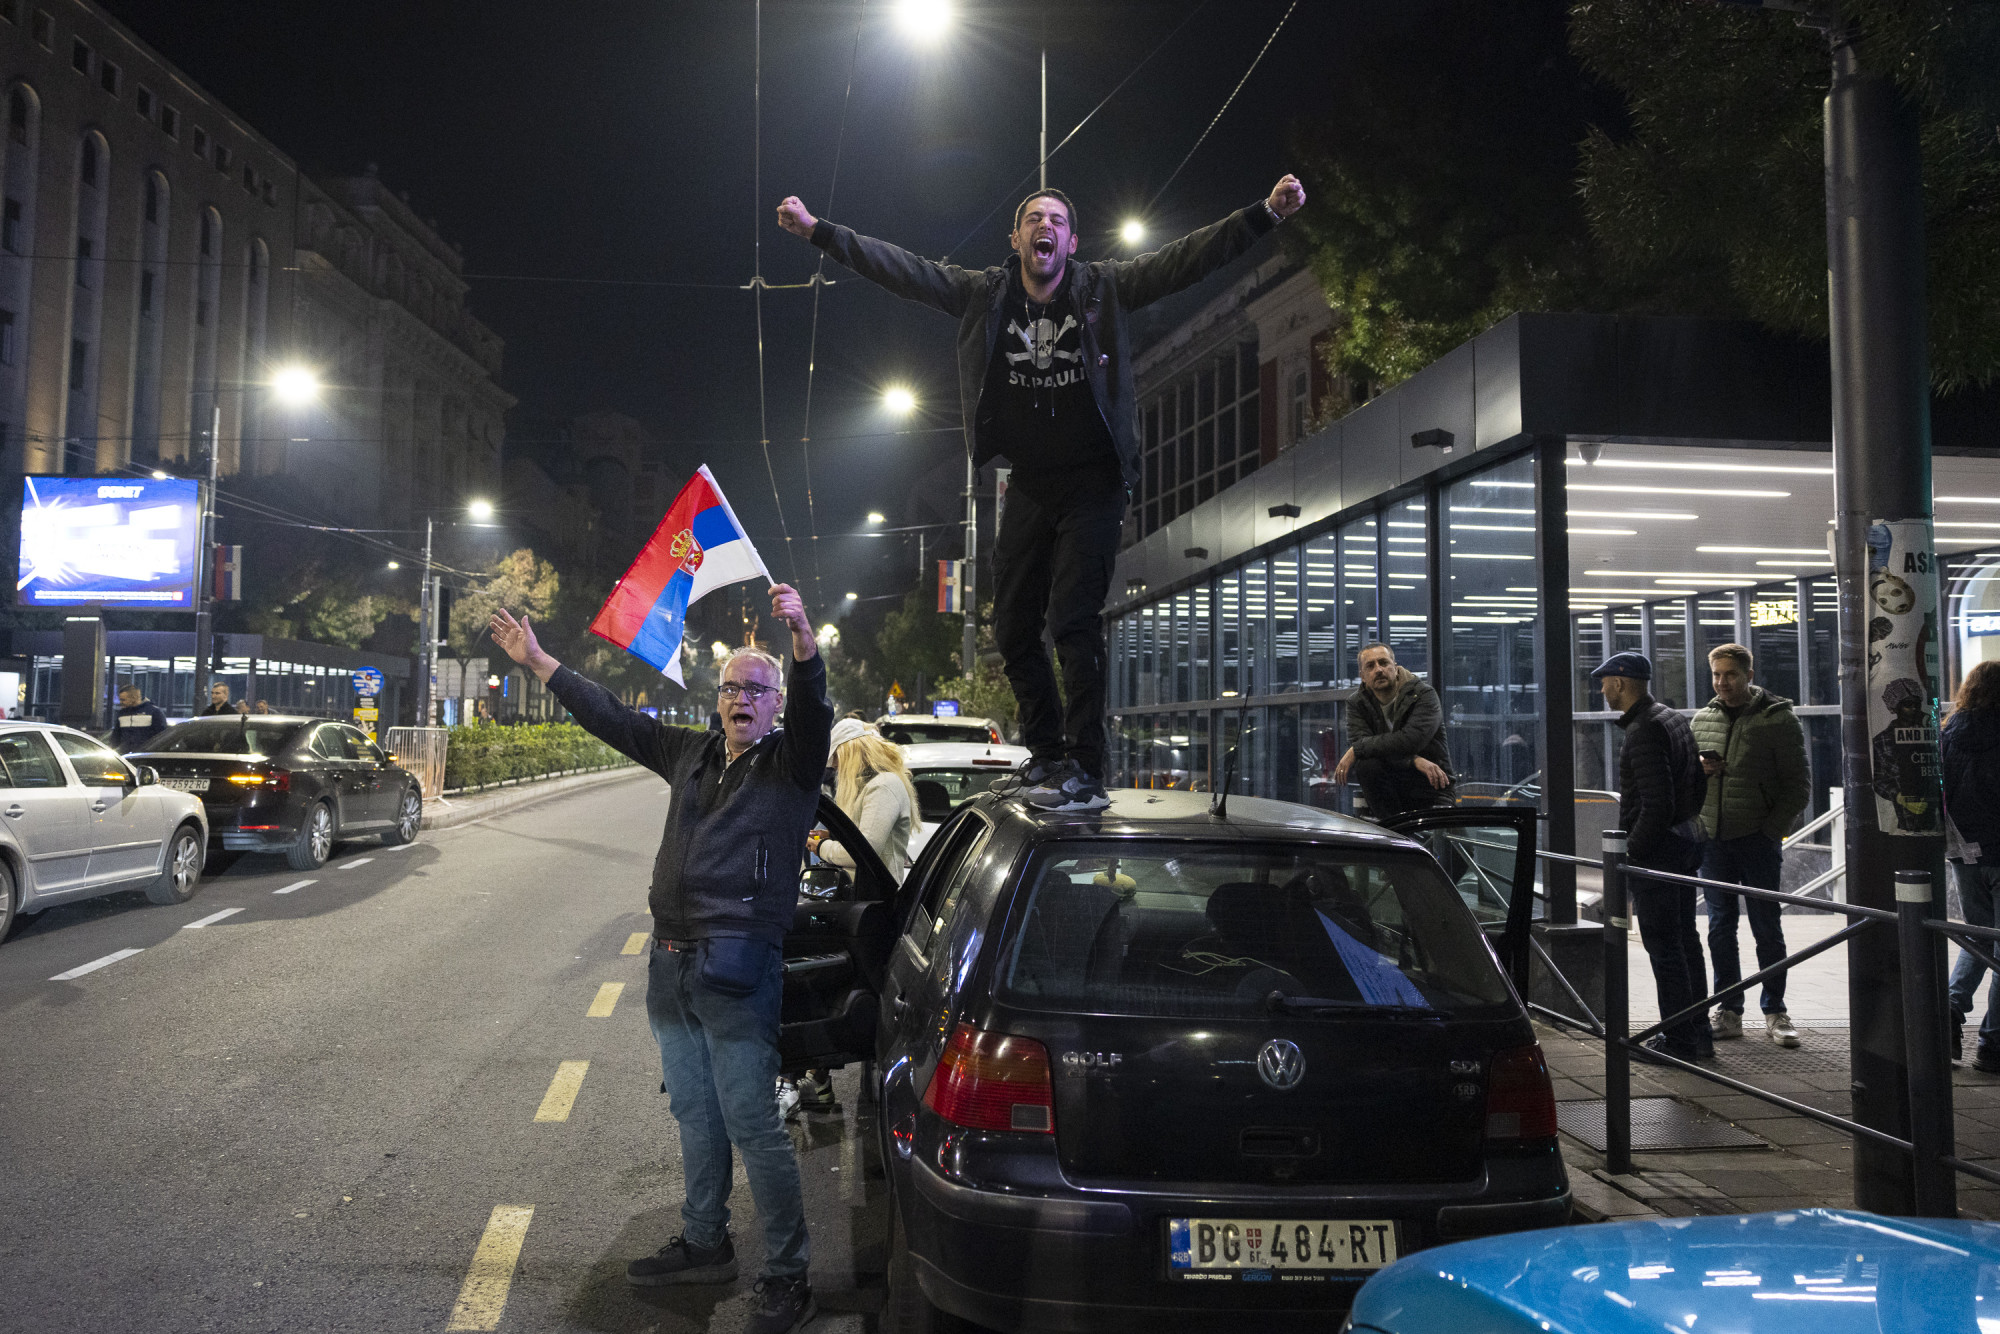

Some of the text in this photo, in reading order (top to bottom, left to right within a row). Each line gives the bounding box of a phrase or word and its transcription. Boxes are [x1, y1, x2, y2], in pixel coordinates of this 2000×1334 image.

[1897, 729, 1921, 741] AND
[1062, 1051, 1123, 1067] GOLF
[1198, 1223, 1241, 1263] BG
